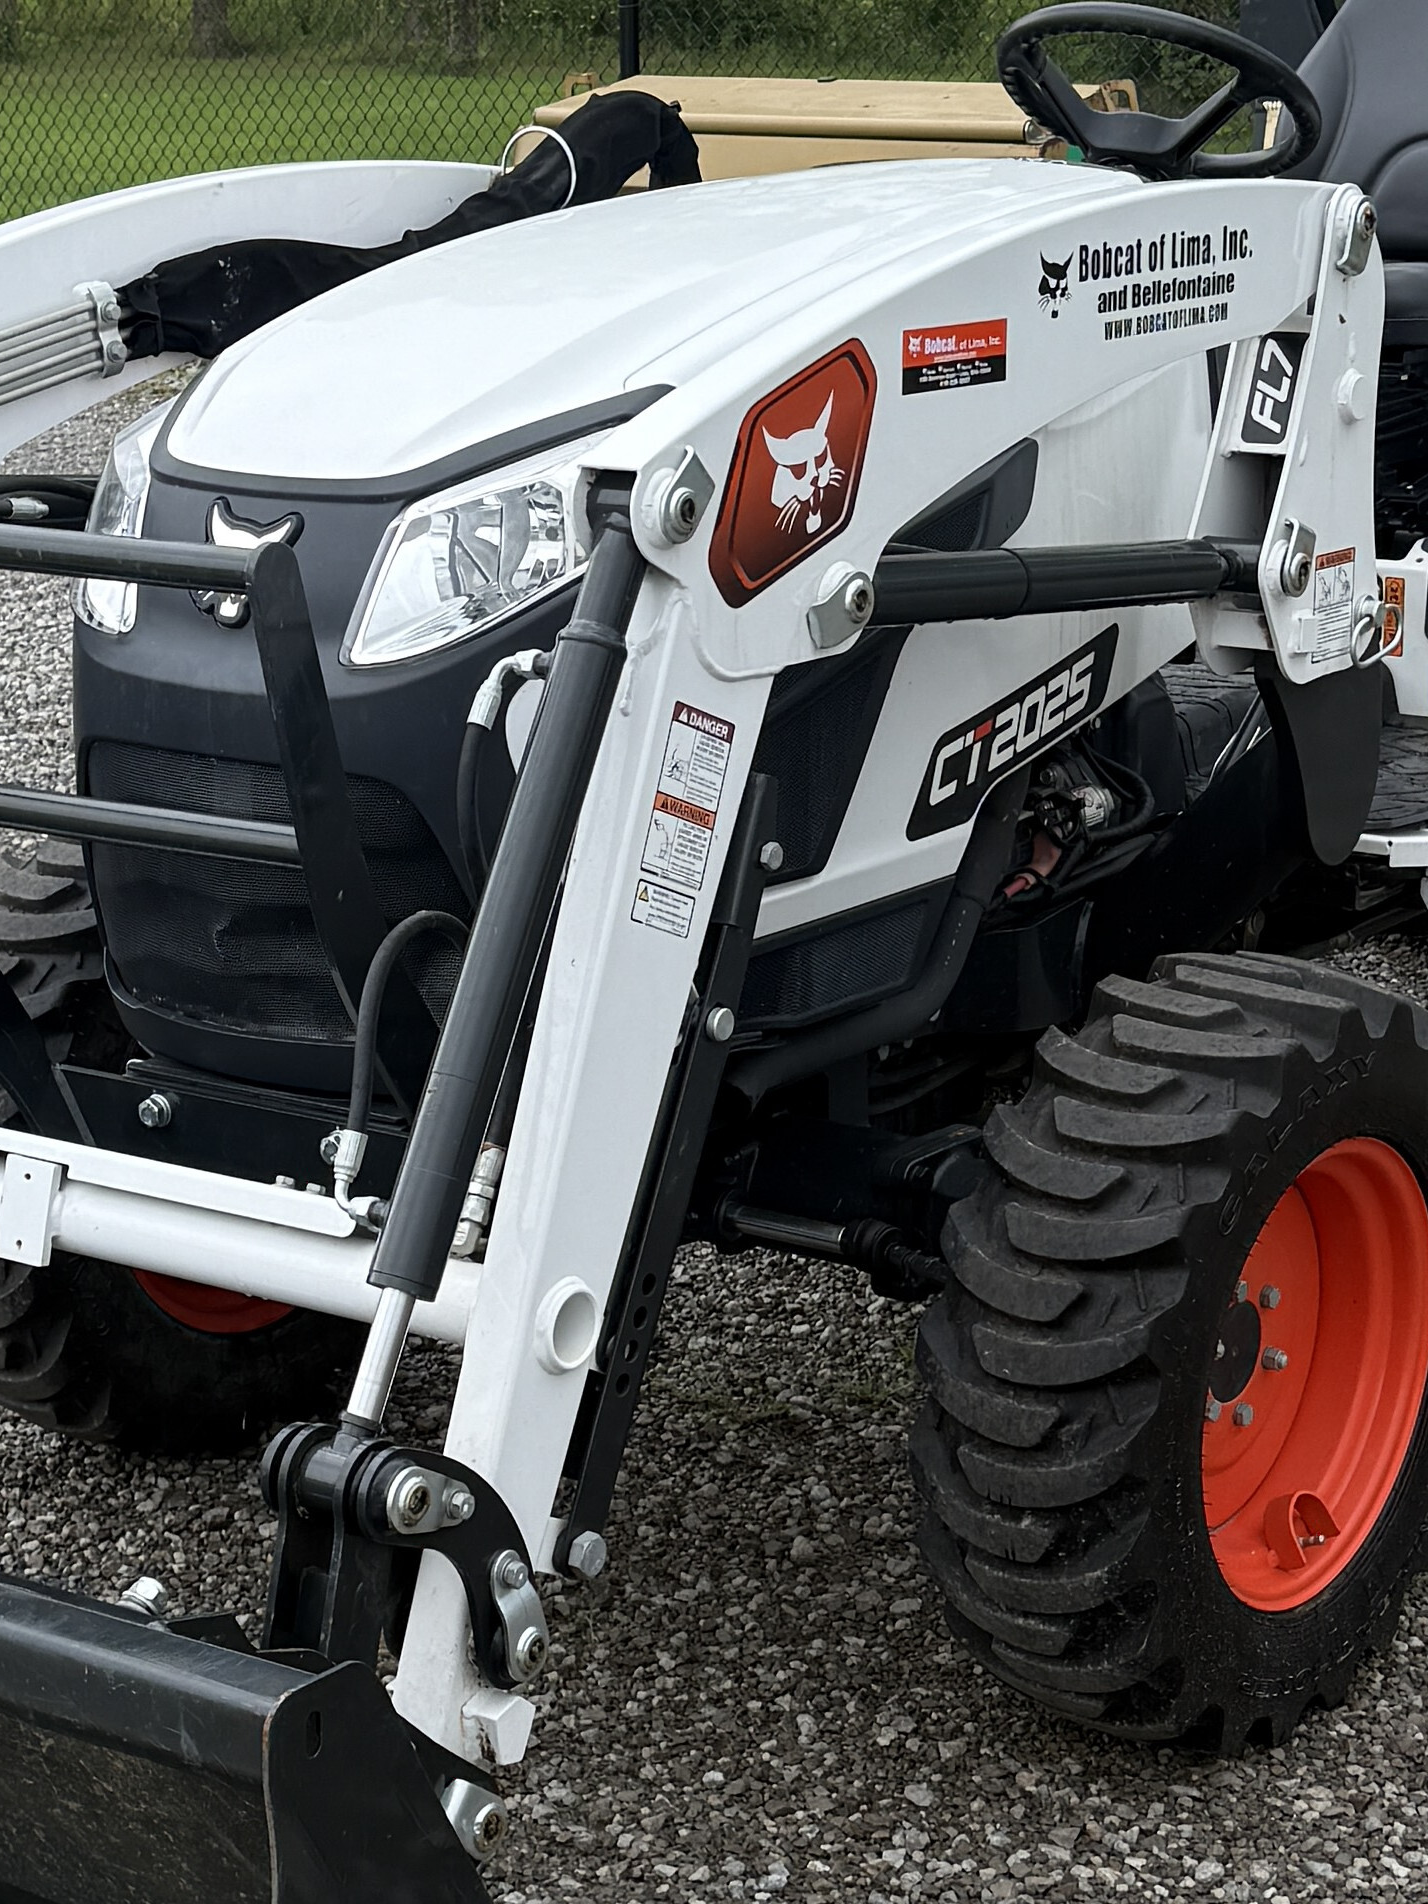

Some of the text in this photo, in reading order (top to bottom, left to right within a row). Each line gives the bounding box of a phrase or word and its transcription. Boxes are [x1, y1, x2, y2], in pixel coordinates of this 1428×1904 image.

[1079, 225, 1253, 282] Bobcat of Lima, Inc.
[1098, 271, 1235, 313] and Bellefontaine
[1104, 302, 1228, 341] WWW.BOBCATOFLIMA.COM
[1251, 338, 1293, 434] FL7
[689, 712, 729, 739] DANGER
[929, 651, 1095, 806] CT2025
[669, 800, 711, 825] WARNING
[1219, 1051, 1376, 1236] GALAXY
